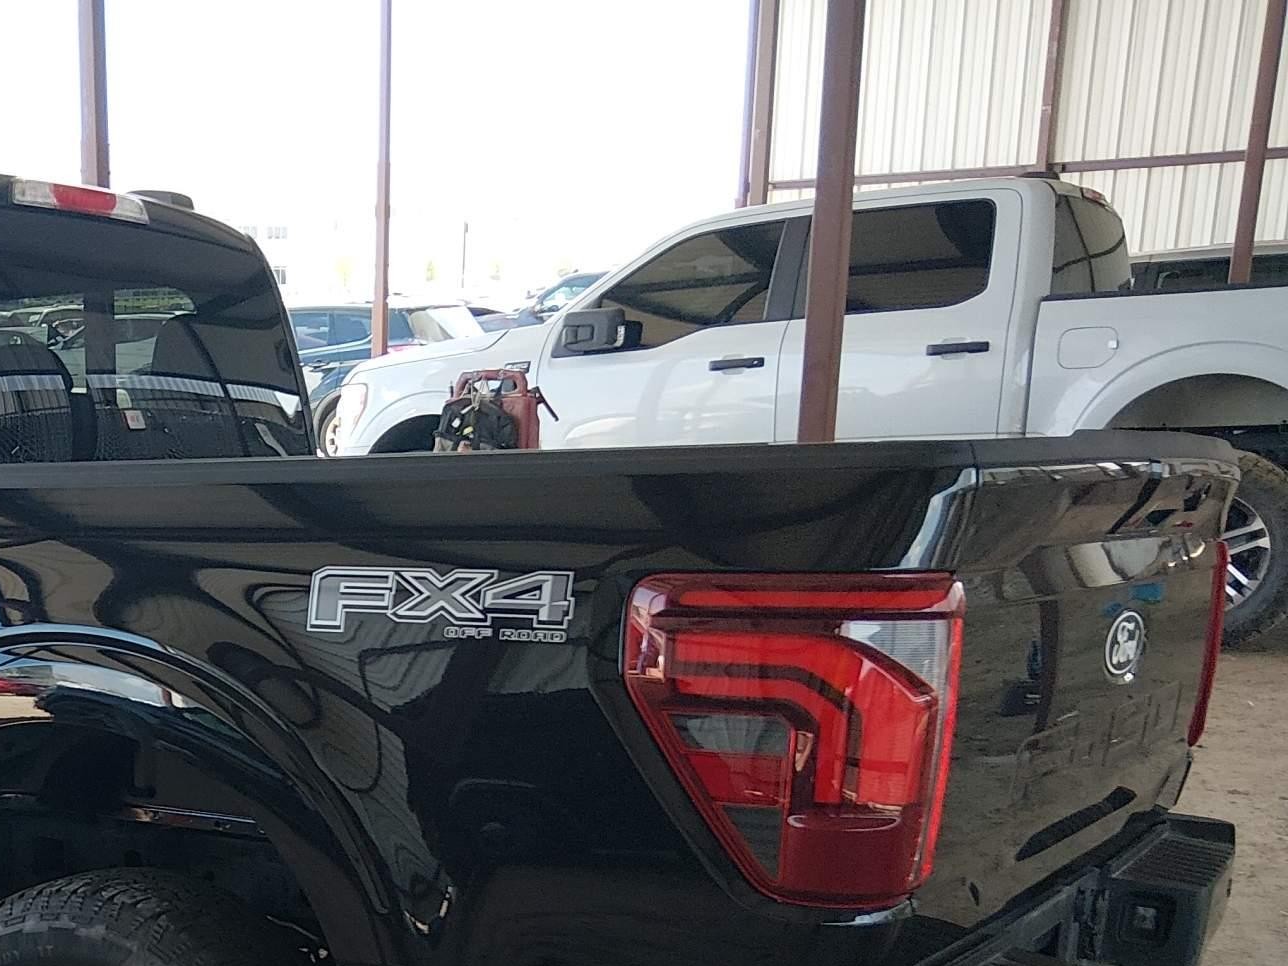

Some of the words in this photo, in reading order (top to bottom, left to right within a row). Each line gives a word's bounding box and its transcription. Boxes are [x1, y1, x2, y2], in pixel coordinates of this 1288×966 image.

[307, 565, 575, 633] FX4
[444, 626, 493, 639] OFF
[498, 627, 568, 643] ROAD
